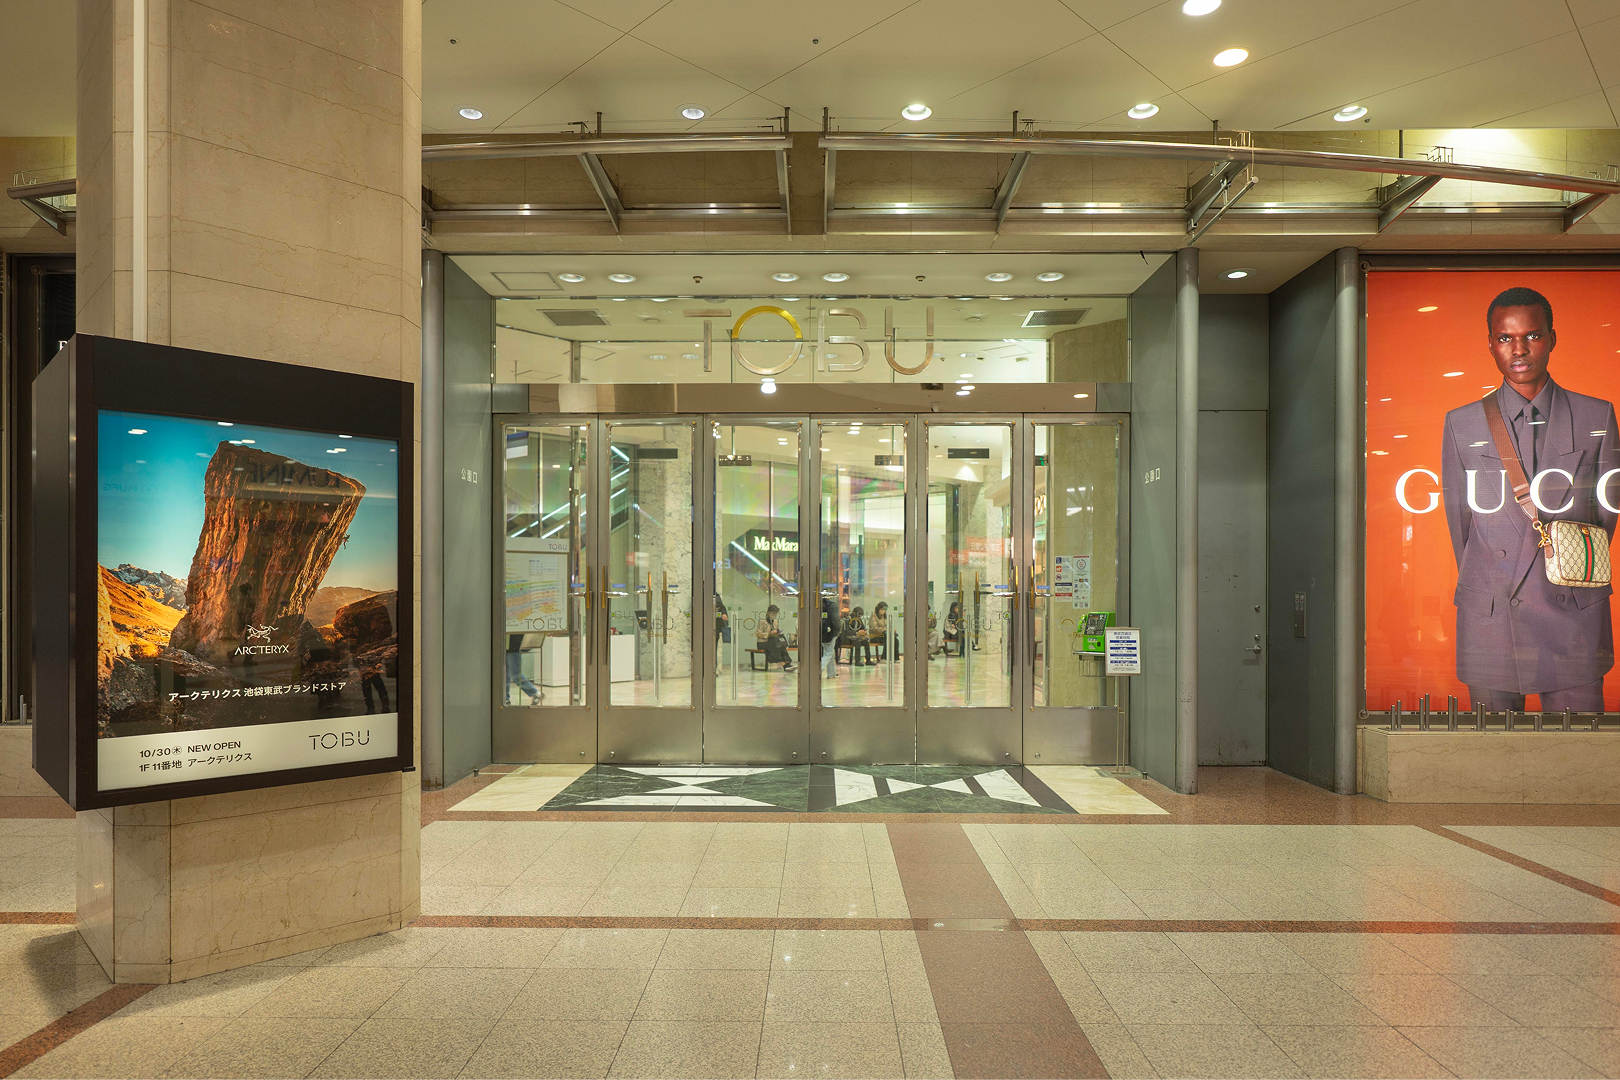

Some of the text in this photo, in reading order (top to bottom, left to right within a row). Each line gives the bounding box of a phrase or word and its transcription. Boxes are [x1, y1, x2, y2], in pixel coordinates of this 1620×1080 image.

[683, 305, 934, 375] TOBU
[461, 468, 477, 484] 公園口
[235, 645, 289, 655] ARC'TERYX
[168, 682, 347, 702] アークテリクス 池袋東武ブランドストア
[188, 744, 211, 753] NEW
[213, 741, 241, 751] OPEN
[309, 730, 369, 750] TOBU
[139, 763, 150, 772] 1F
[188, 753, 252, 767] アークテリクス
